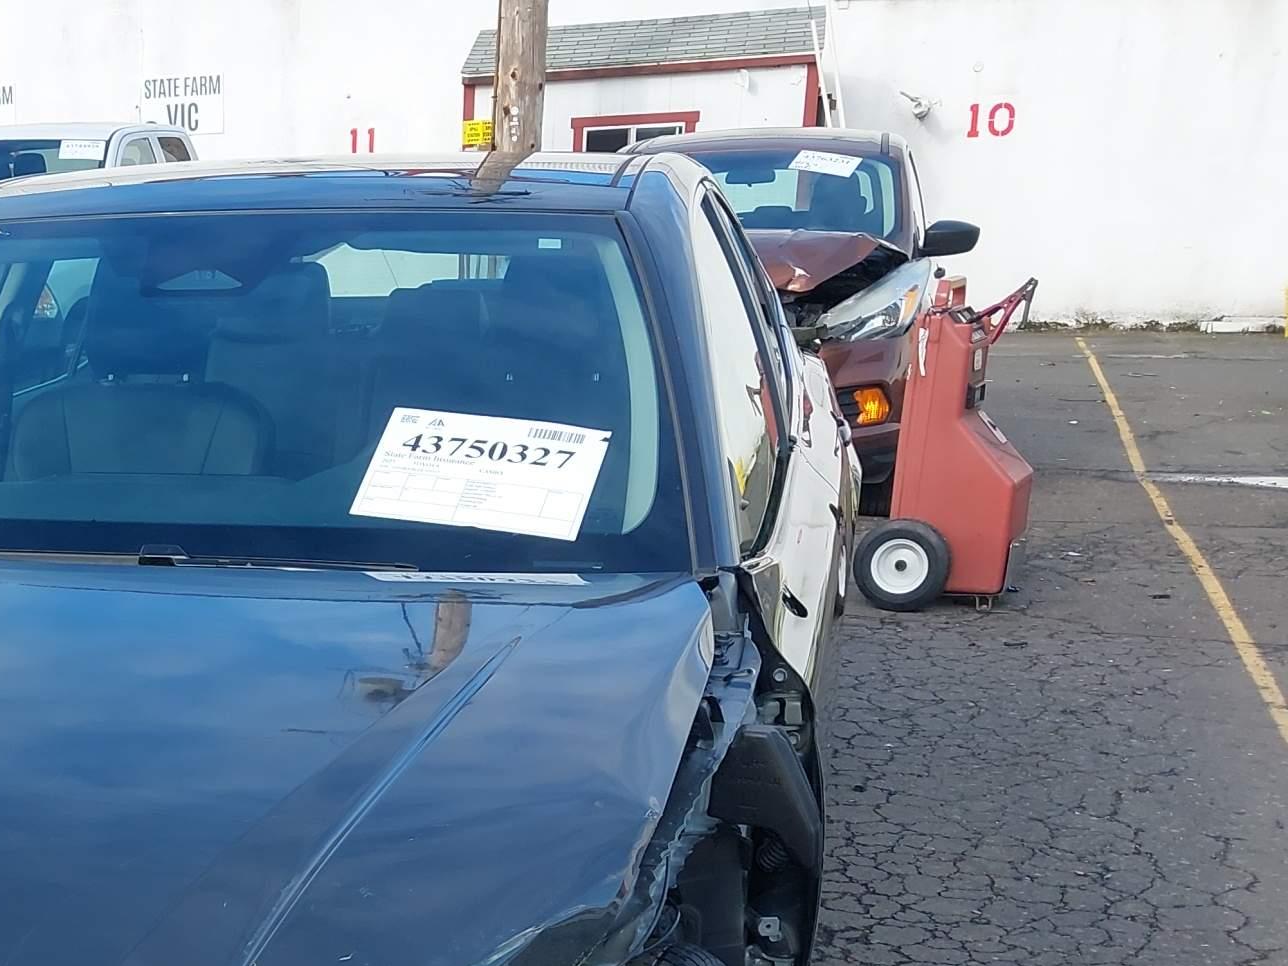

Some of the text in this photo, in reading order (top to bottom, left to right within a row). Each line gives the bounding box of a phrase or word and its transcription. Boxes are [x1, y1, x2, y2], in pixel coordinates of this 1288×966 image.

[144, 75, 221, 99] STATE FARM
[167, 102, 199, 131] VIC
[967, 102, 1015, 138] 10
[350, 127, 375, 153] 11
[401, 433, 577, 469] 43750327
